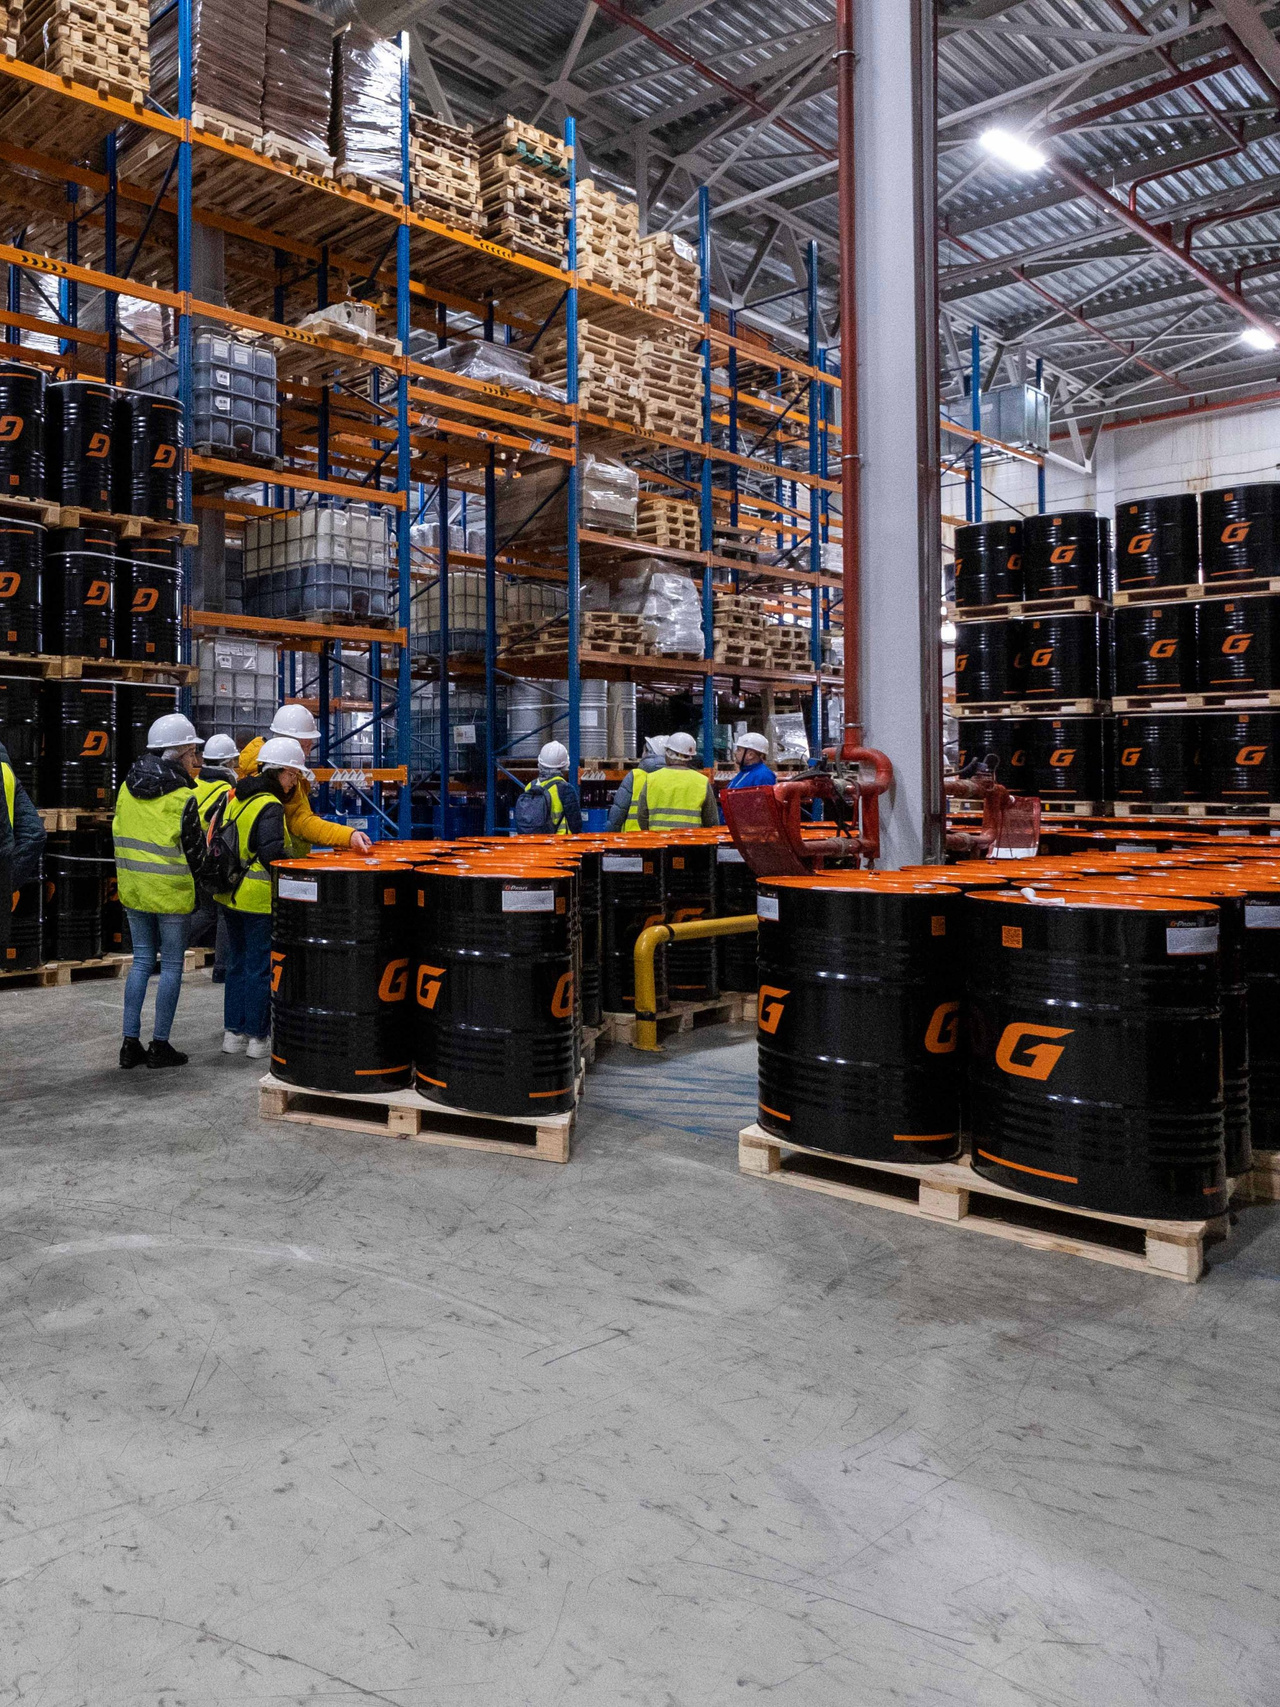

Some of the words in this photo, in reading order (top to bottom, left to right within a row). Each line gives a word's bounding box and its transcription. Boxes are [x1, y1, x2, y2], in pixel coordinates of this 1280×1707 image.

[1221, 522, 1253, 543] G
[1128, 533, 1154, 554] G
[1050, 545, 1077, 564] G
[1149, 639, 1179, 658] G
[1222, 633, 1254, 654] G
[1031, 648, 1054, 666] G
[1050, 749, 1076, 766] G
[1122, 748, 1142, 766] G
[1236, 746, 1267, 765] G
[378, 958, 409, 1002] G
[417, 965, 446, 1009] G
[756, 985, 790, 1034] G
[996, 1022, 1074, 1081] G
